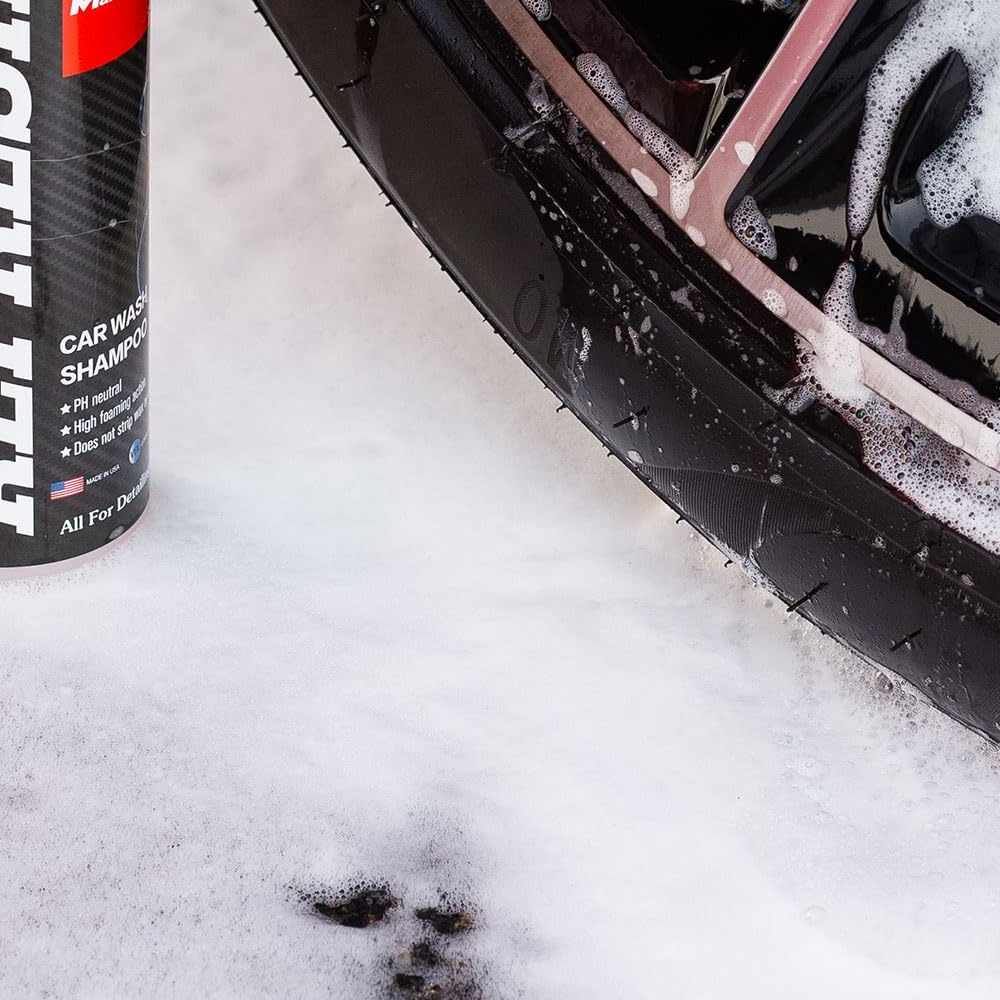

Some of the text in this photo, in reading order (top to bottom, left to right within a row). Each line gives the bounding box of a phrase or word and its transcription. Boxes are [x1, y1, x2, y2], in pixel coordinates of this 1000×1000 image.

[59, 284, 148, 355] CAR WASH
[60, 316, 148, 386] SHAMPOO
[74, 395, 89, 413] PH
[92, 378, 122, 407] neutral
[74, 415, 97, 435] High
[100, 396, 131, 425] foaming
[74, 438, 99, 456] Does
[101, 427, 116, 446] not
[117, 416, 133, 436] strip
[86, 464, 120, 485] MADE IN USA
[60, 515, 84, 536] All
[88, 505, 114, 526] For
